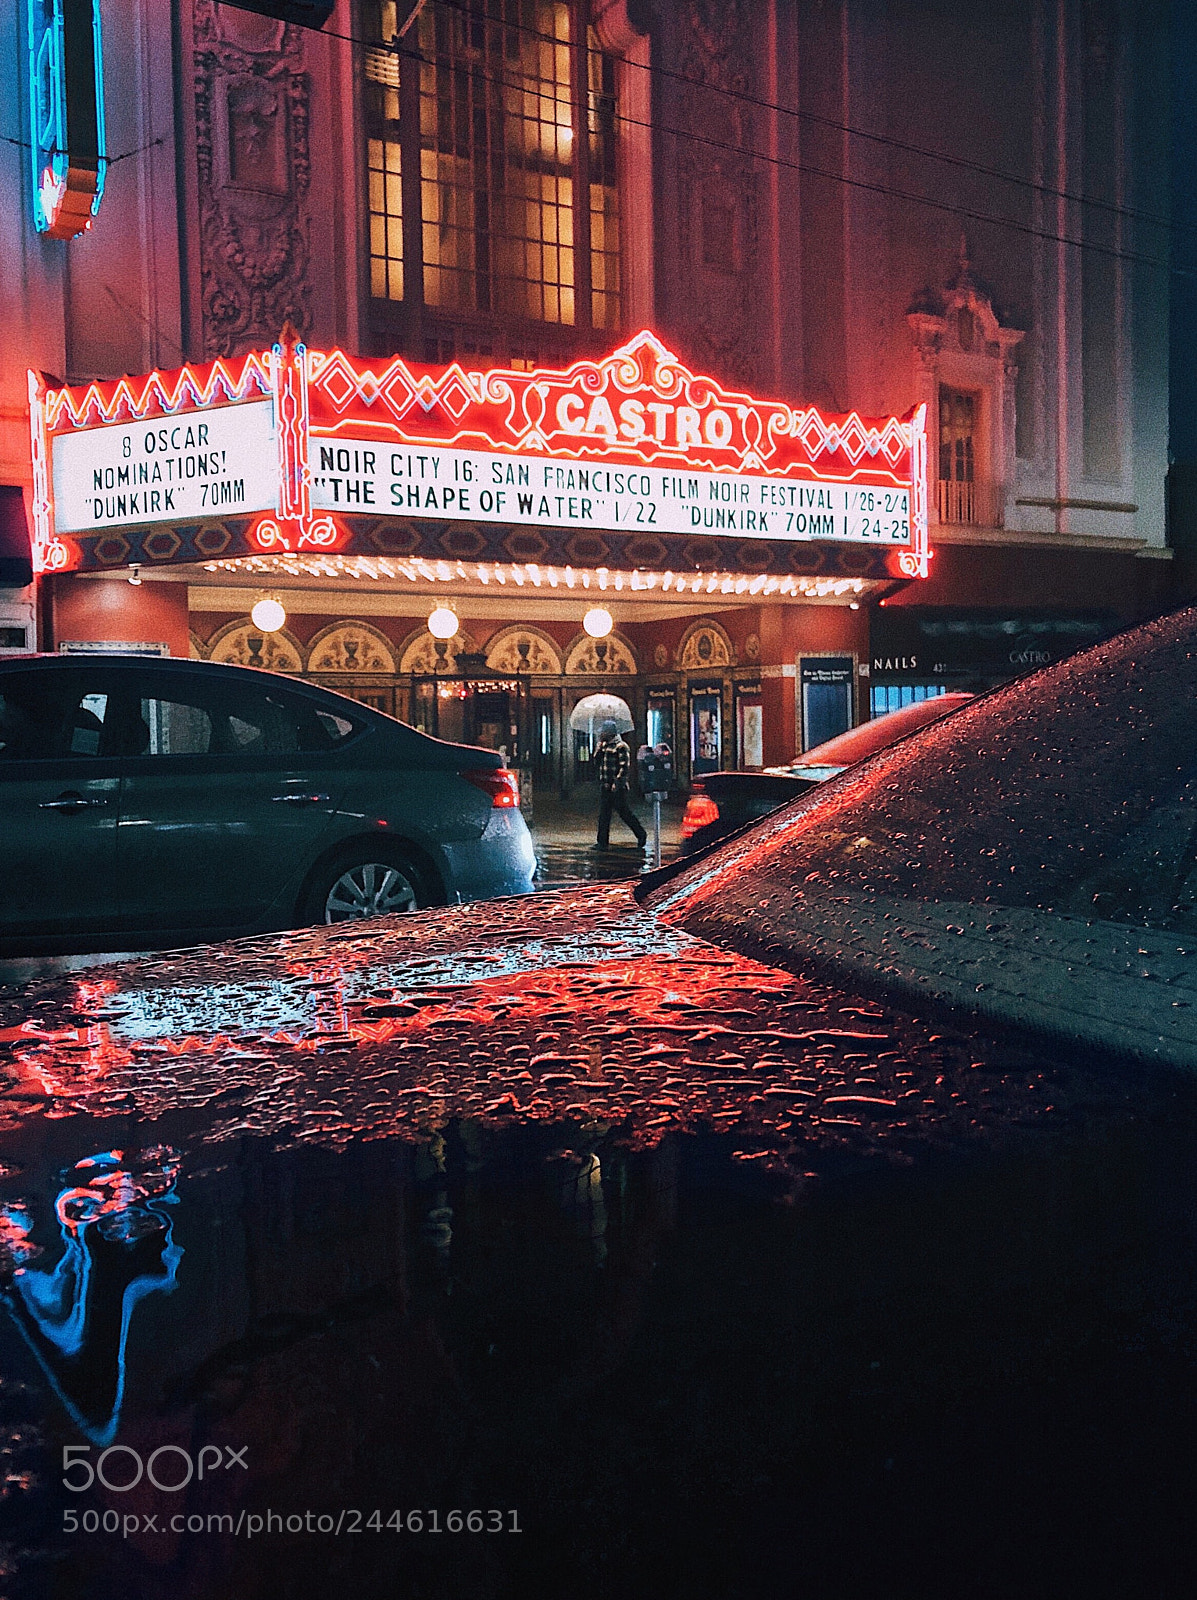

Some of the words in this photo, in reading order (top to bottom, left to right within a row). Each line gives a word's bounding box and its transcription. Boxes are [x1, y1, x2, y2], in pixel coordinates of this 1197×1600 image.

[122, 436, 132, 458] 8
[144, 423, 209, 454] OSCAR
[556, 394, 733, 447] CASTRO
[93, 450, 226, 491] NOMINATIONS!
[320, 446, 376, 475] NOIR
[390, 453, 440, 480] CITY
[454, 458, 479, 483] 16:
[492, 461, 530, 487] SAN
[543, 466, 651, 496] FRANCISCO
[662, 476, 699, 500] FILM
[709, 480, 750, 504] NOIR
[761, 484, 834, 511] FESTIVAL
[844, 491, 908, 514] 1/26-2/4
[85, 487, 185, 520] "DUNKIRK"
[200, 478, 245, 508] 70MM
[314, 477, 375, 505] "THE
[390, 483, 471, 512] SHAPE
[479, 490, 507, 514] OF
[517, 492, 606, 520] WATER"
[615, 501, 657, 524] 1/22
[682, 504, 779, 532] "DUNKIRK"
[786, 512, 835, 535] 70MM
[843, 517, 909, 539] 1/24-25
[874, 656, 917, 670] NAILS
[1009, 650, 1051, 663] CASTRO
